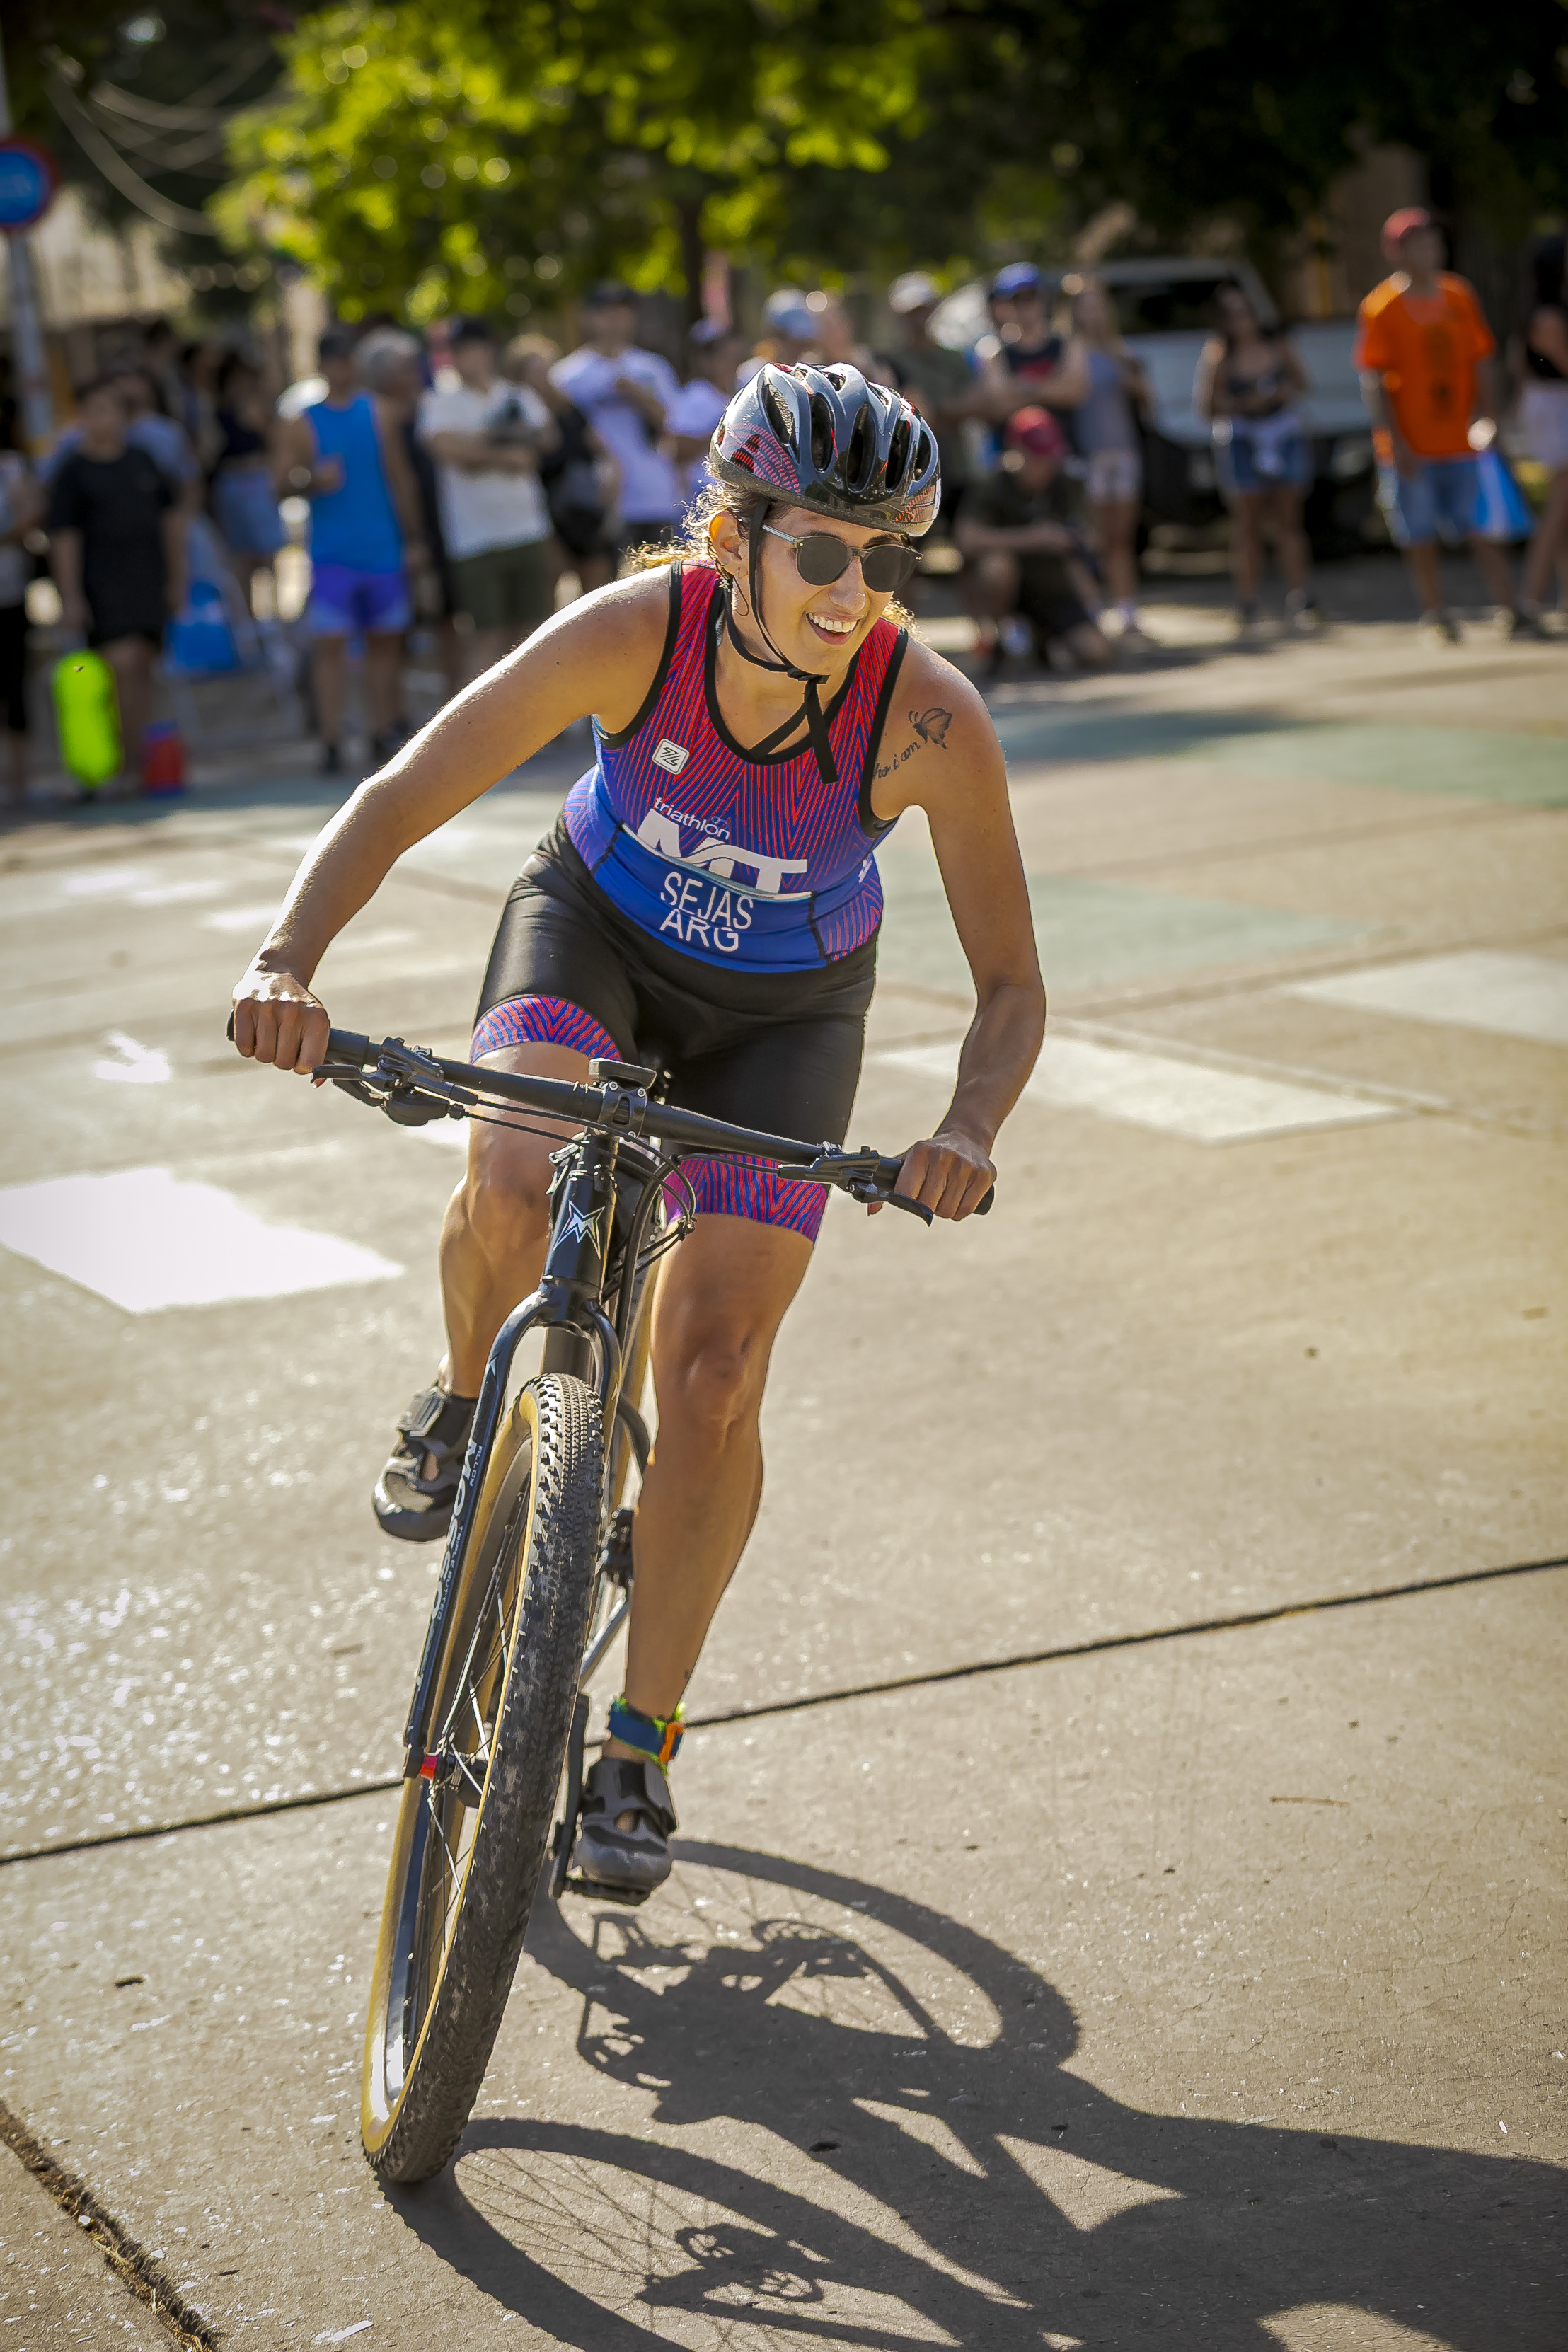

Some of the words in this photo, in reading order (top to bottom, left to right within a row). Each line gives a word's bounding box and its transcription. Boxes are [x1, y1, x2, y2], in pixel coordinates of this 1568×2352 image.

[900, 741, 921, 762] am
[655, 797, 730, 841] triathlon
[660, 872, 754, 930] SEJAS
[659, 908, 739, 952] ARG
